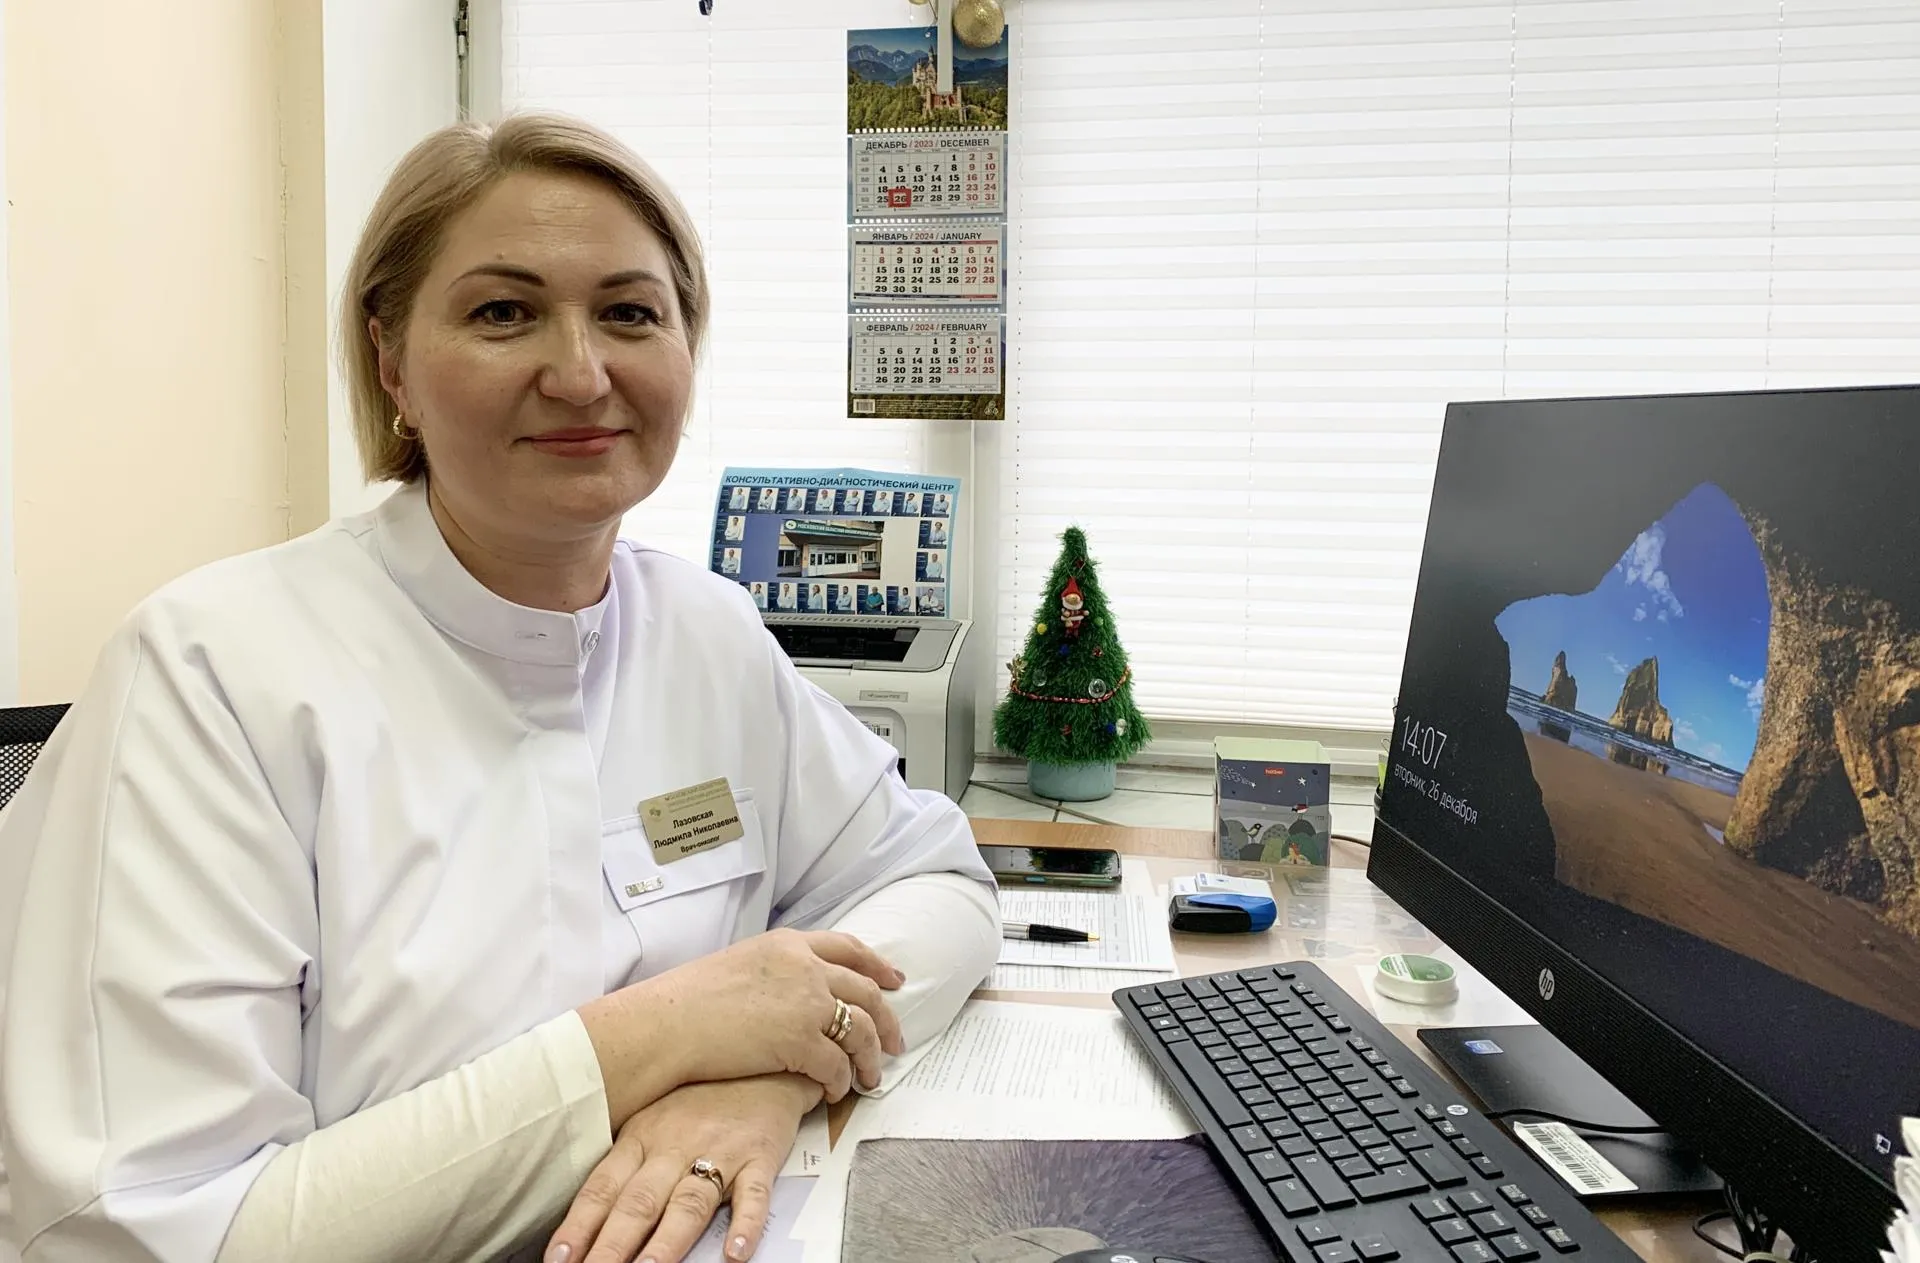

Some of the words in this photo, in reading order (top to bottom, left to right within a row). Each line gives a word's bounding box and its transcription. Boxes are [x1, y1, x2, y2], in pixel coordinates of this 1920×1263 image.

[866, 141, 907, 150] ДЕКАБРЬ
[941, 138, 989, 147] DECEMBER
[985, 163, 996, 171] 10
[913, 175, 924, 183] 13
[949, 174, 960, 182] 15
[967, 173, 978, 181] 16
[985, 173, 996, 181] 17
[948, 184, 961, 192] 22
[966, 183, 979, 191] 23
[966, 193, 979, 201] 30
[982, 276, 995, 284] 28
[725, 475, 919, 489] КОНСУЛЬТАТИВНО-ДИАГНОСТИЧЕСКИЙ
[922, 483, 955, 492] ЦЕНТР
[1402, 715, 1447, 770] 14:07
[1394, 764, 1425, 796] вторник,
[1428, 780, 1440, 801] 26
[1439, 792, 1478, 825] декабря
[673, 810, 714, 829] Лазовская
[654, 831, 692, 849] Людмила
[693, 815, 739, 836] Николаевна
[680, 835, 720, 853] Врач-онколог
[1539, 968, 1554, 1000] hp
